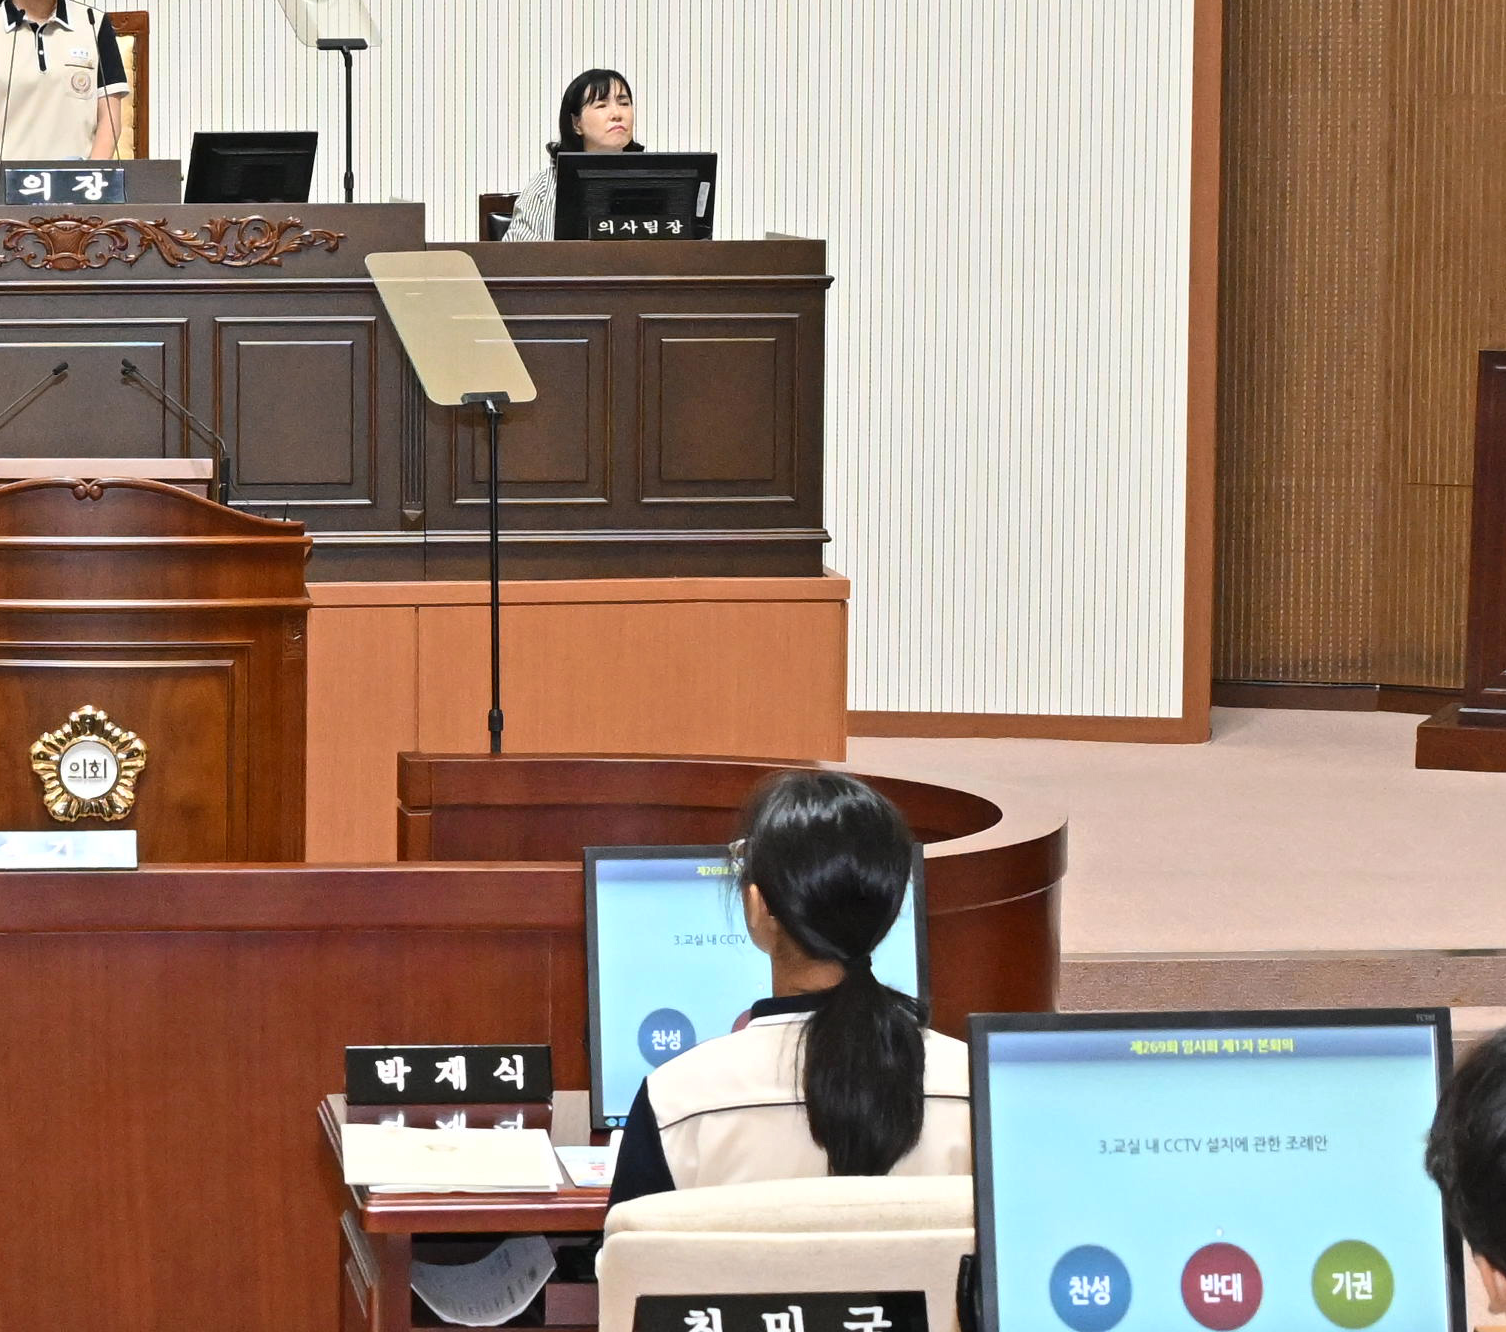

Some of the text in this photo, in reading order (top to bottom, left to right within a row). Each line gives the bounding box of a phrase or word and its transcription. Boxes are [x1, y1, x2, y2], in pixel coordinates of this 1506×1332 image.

[66, 757, 108, 780] 의회
[706, 934, 717, 946] 내
[720, 934, 747, 945] CCTV
[651, 1029, 682, 1051] 찬성
[1145, 1138, 1159, 1154] 내
[1164, 1138, 1202, 1153] CCTV
[1206, 1136, 1248, 1154] 설치에
[1253, 1135, 1281, 1154] 관한
[1068, 1274, 1112, 1307] 찬성
[1199, 1272, 1244, 1304] 반대
[1331, 1269, 1374, 1301] 기권
